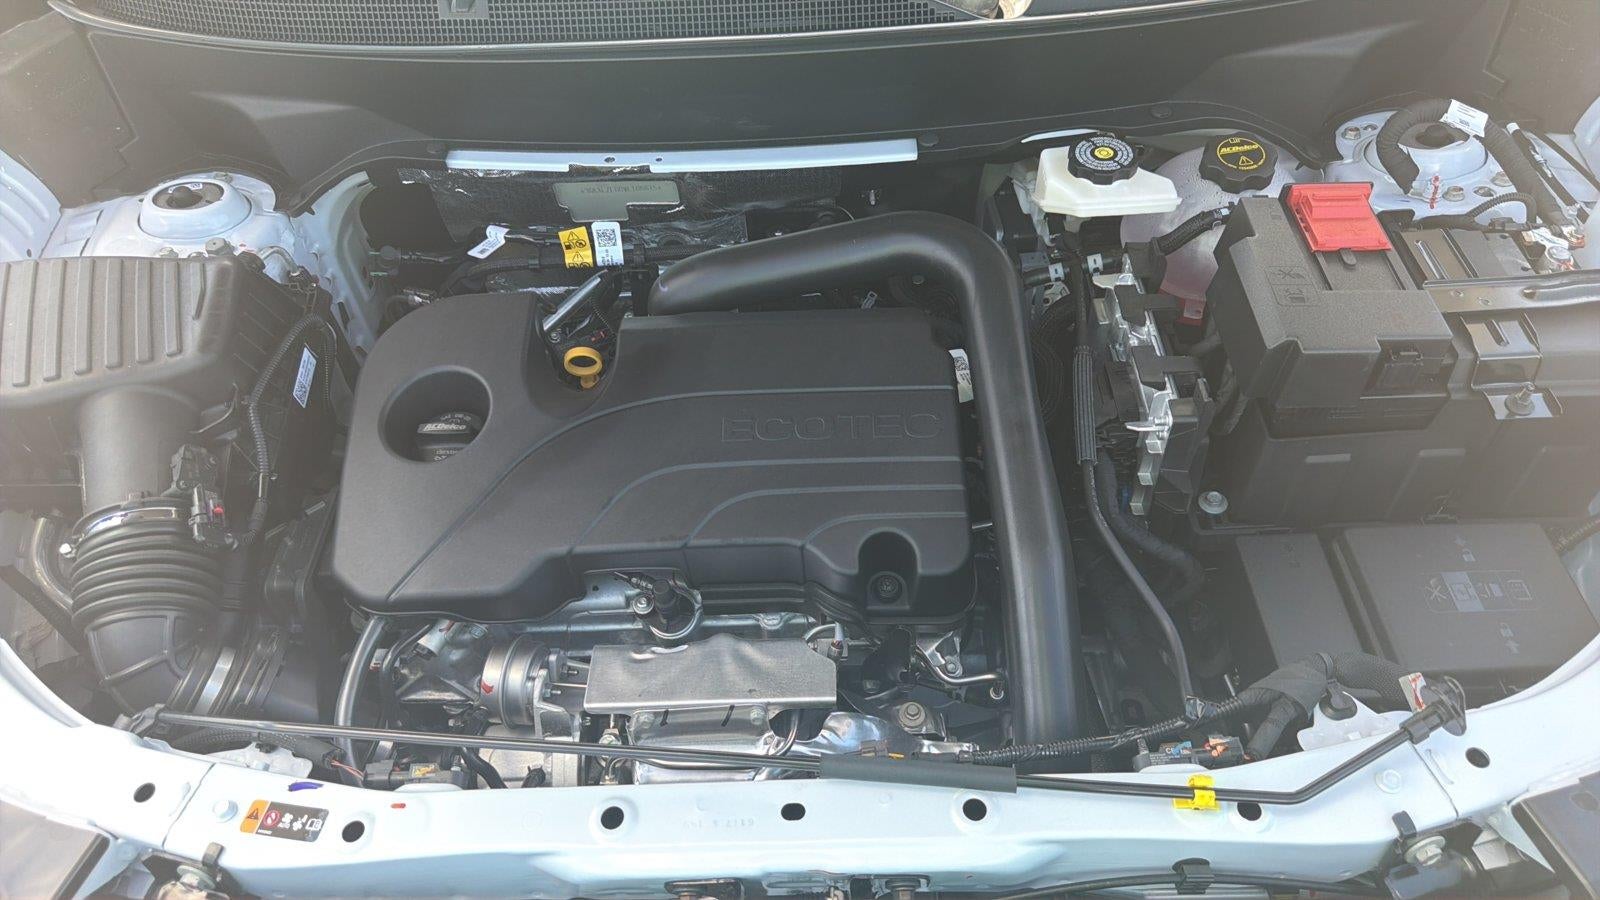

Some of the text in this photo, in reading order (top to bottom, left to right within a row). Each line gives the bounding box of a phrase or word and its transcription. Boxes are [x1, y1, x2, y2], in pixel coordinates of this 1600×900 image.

[1220, 144, 1260, 154] ACDelco
[423, 423, 466, 431] ACDelco
[721, 413, 941, 442] ECOTEC
